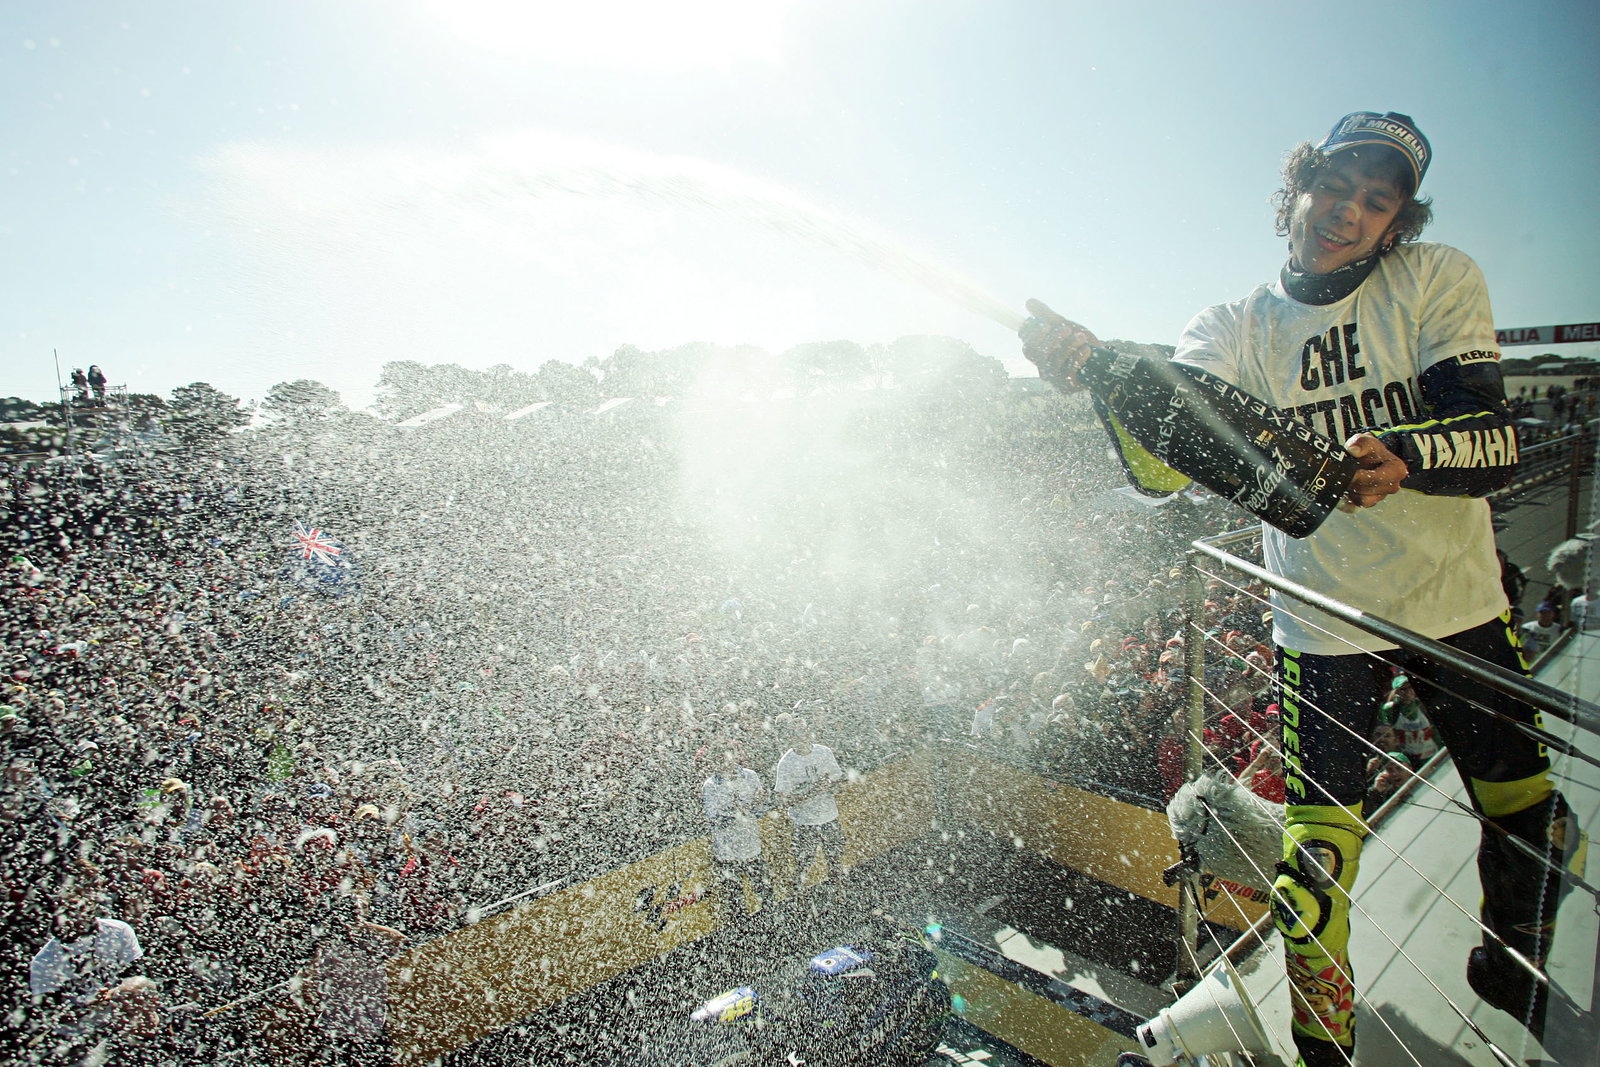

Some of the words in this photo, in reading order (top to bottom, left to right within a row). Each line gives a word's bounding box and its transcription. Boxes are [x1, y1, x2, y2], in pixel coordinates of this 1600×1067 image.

[1366, 119, 1425, 161] MICHELIN
[1300, 322, 1366, 391] CHE
[1496, 328, 1540, 344] ALIA
[1194, 372, 1347, 462] FREIXENET
[1411, 425, 1519, 470] YAMAHA
[1293, 477, 1326, 516] NEGRO
